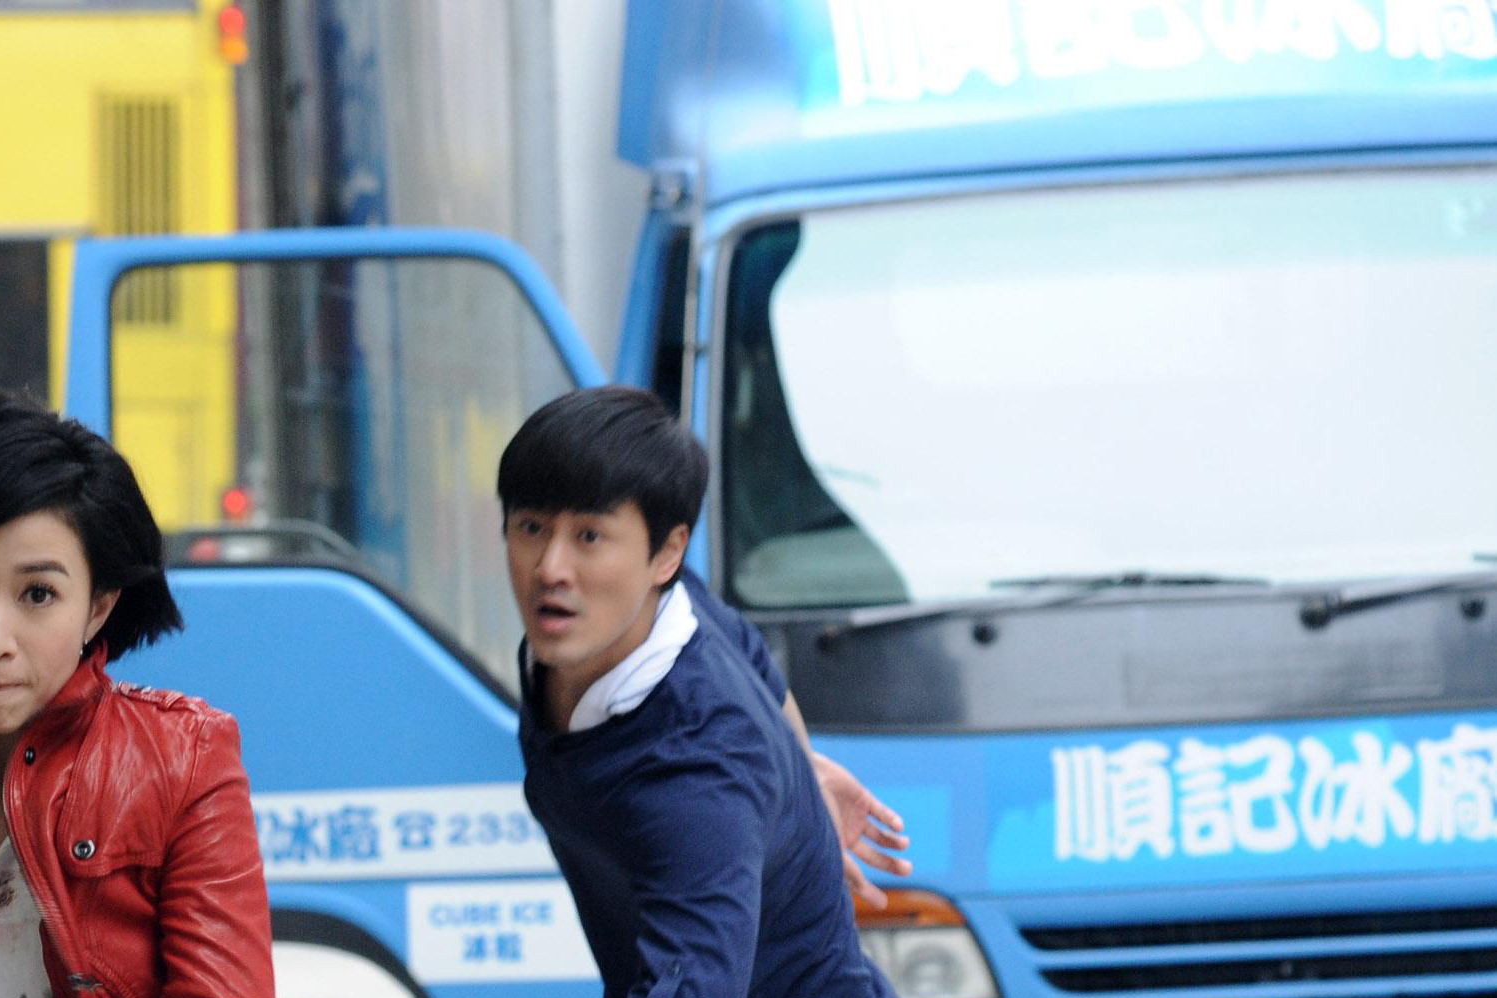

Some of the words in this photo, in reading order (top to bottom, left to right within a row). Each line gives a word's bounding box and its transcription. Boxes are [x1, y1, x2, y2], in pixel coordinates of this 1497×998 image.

[1051, 724, 1497, 863] 順記冰廠
[254, 803, 381, 864] 冰廠
[447, 812, 546, 846] 233
[429, 902, 501, 927] CUBE
[510, 901, 551, 924] ICE
